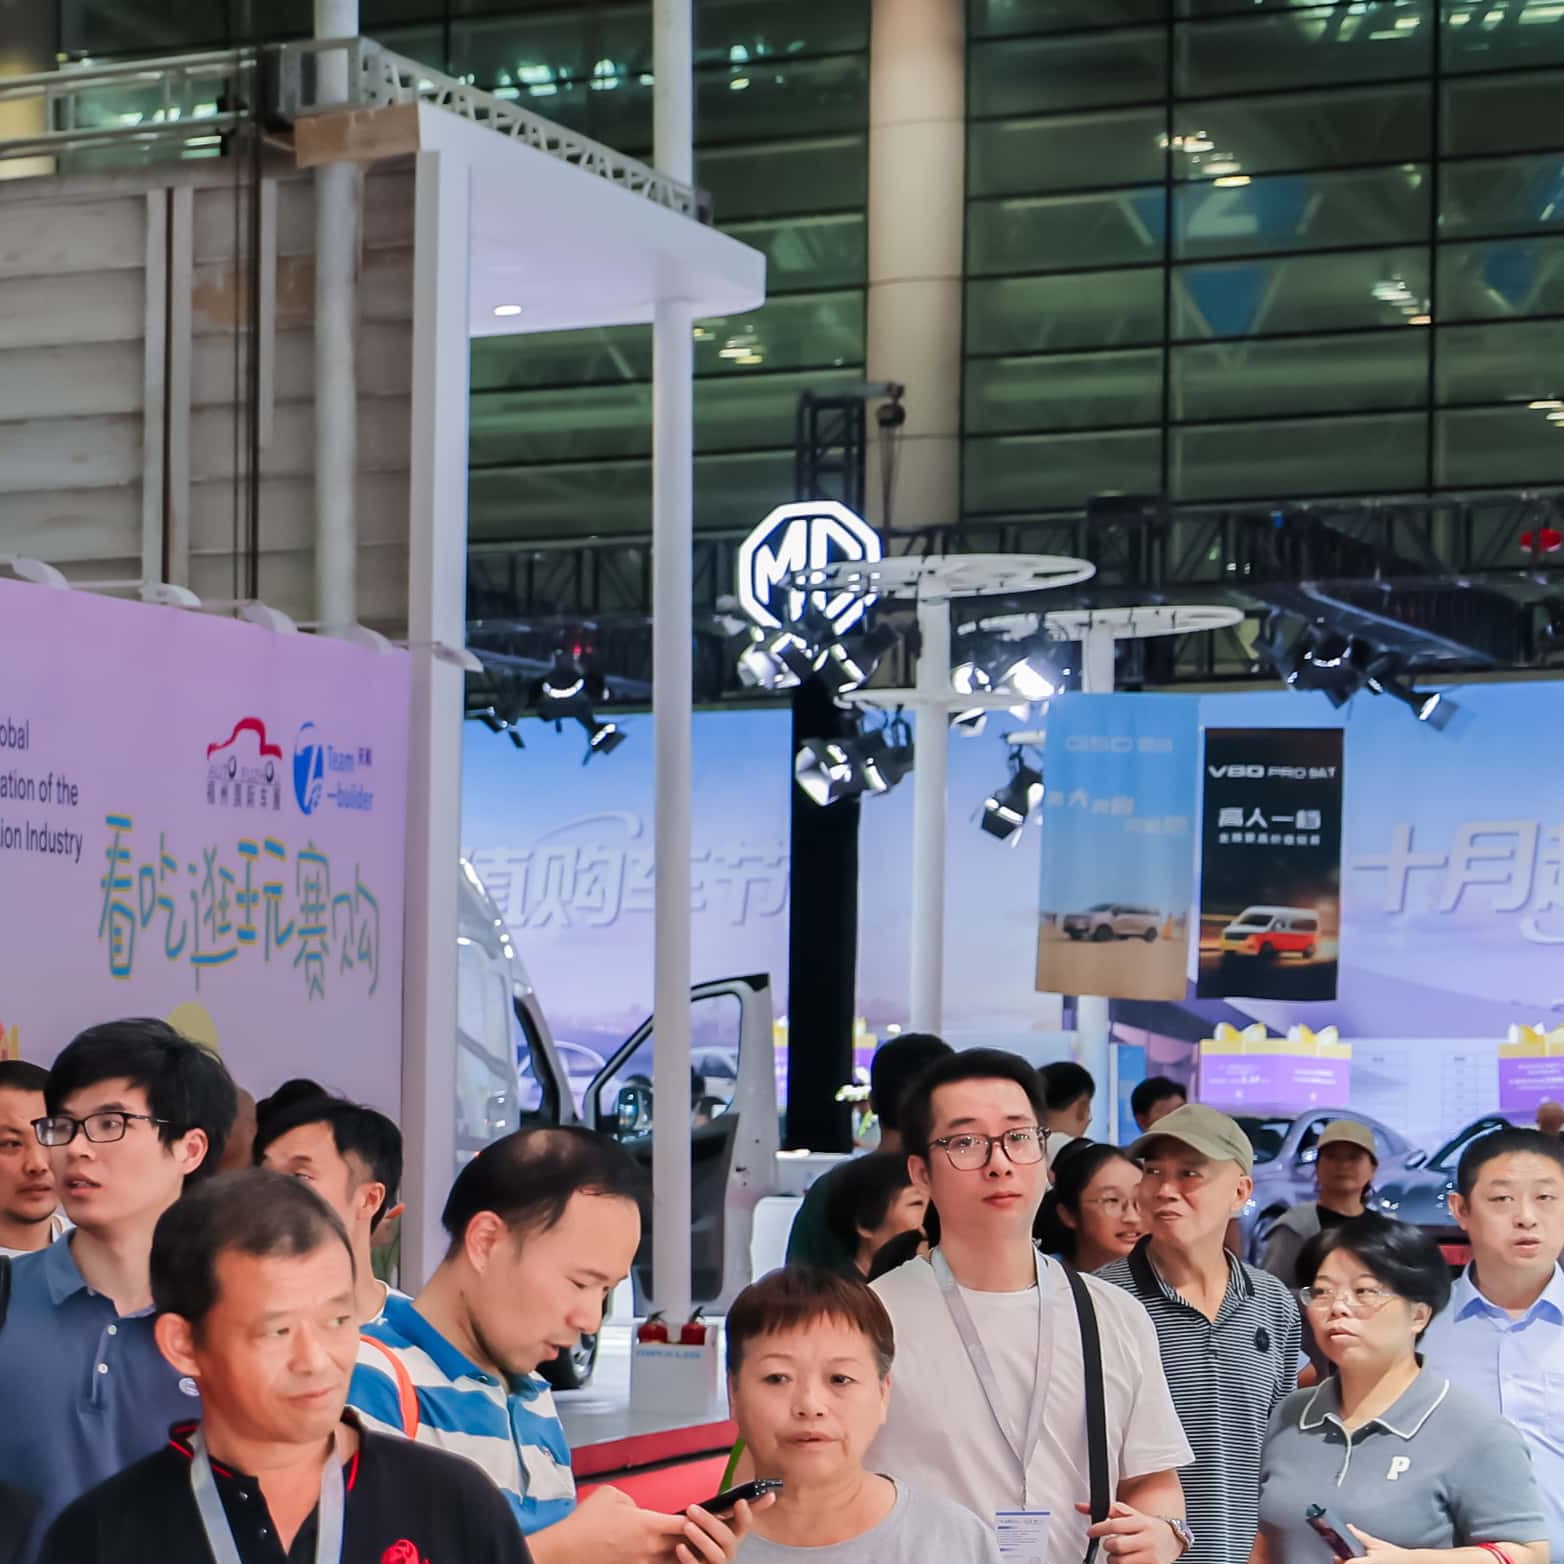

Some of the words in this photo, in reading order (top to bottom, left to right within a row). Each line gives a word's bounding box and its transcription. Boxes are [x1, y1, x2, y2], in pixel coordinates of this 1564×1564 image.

[38, 771, 53, 803] of
[56, 774, 79, 807] the
[25, 820, 84, 865] Industry
[1351, 820, 1564, 916] 十月
[96, 813, 381, 1003] 看吃逛玩赛购
[1386, 1455, 1411, 1481] P
